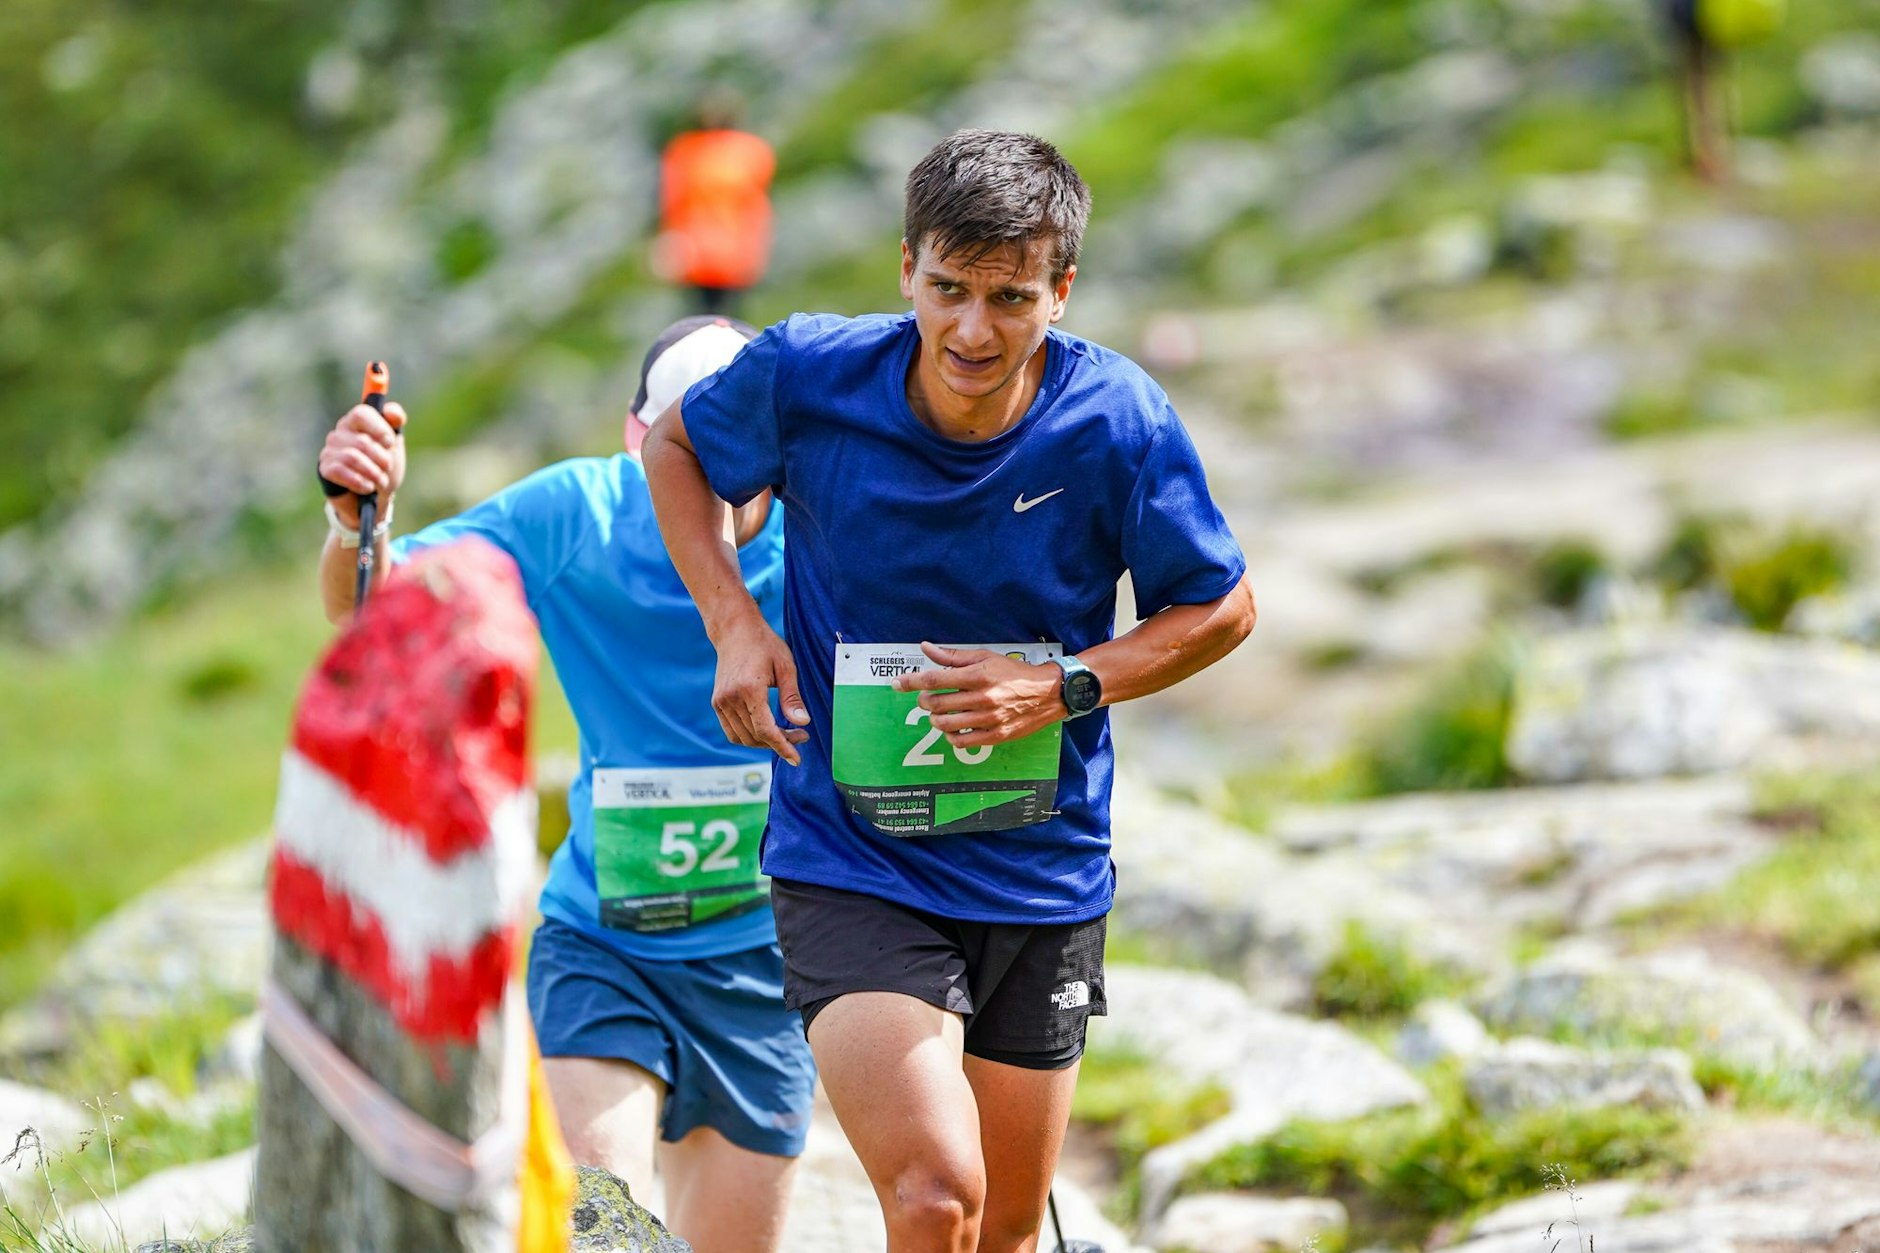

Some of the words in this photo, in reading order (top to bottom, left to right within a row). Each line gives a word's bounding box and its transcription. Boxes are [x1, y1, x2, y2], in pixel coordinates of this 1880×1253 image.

[870, 657, 905, 665] SCHLEGEIS
[659, 819, 740, 877] 52
[1064, 982, 1078, 993] THE
[1051, 991, 1078, 1003] NORTH
[1058, 1000, 1079, 1010] FACE
